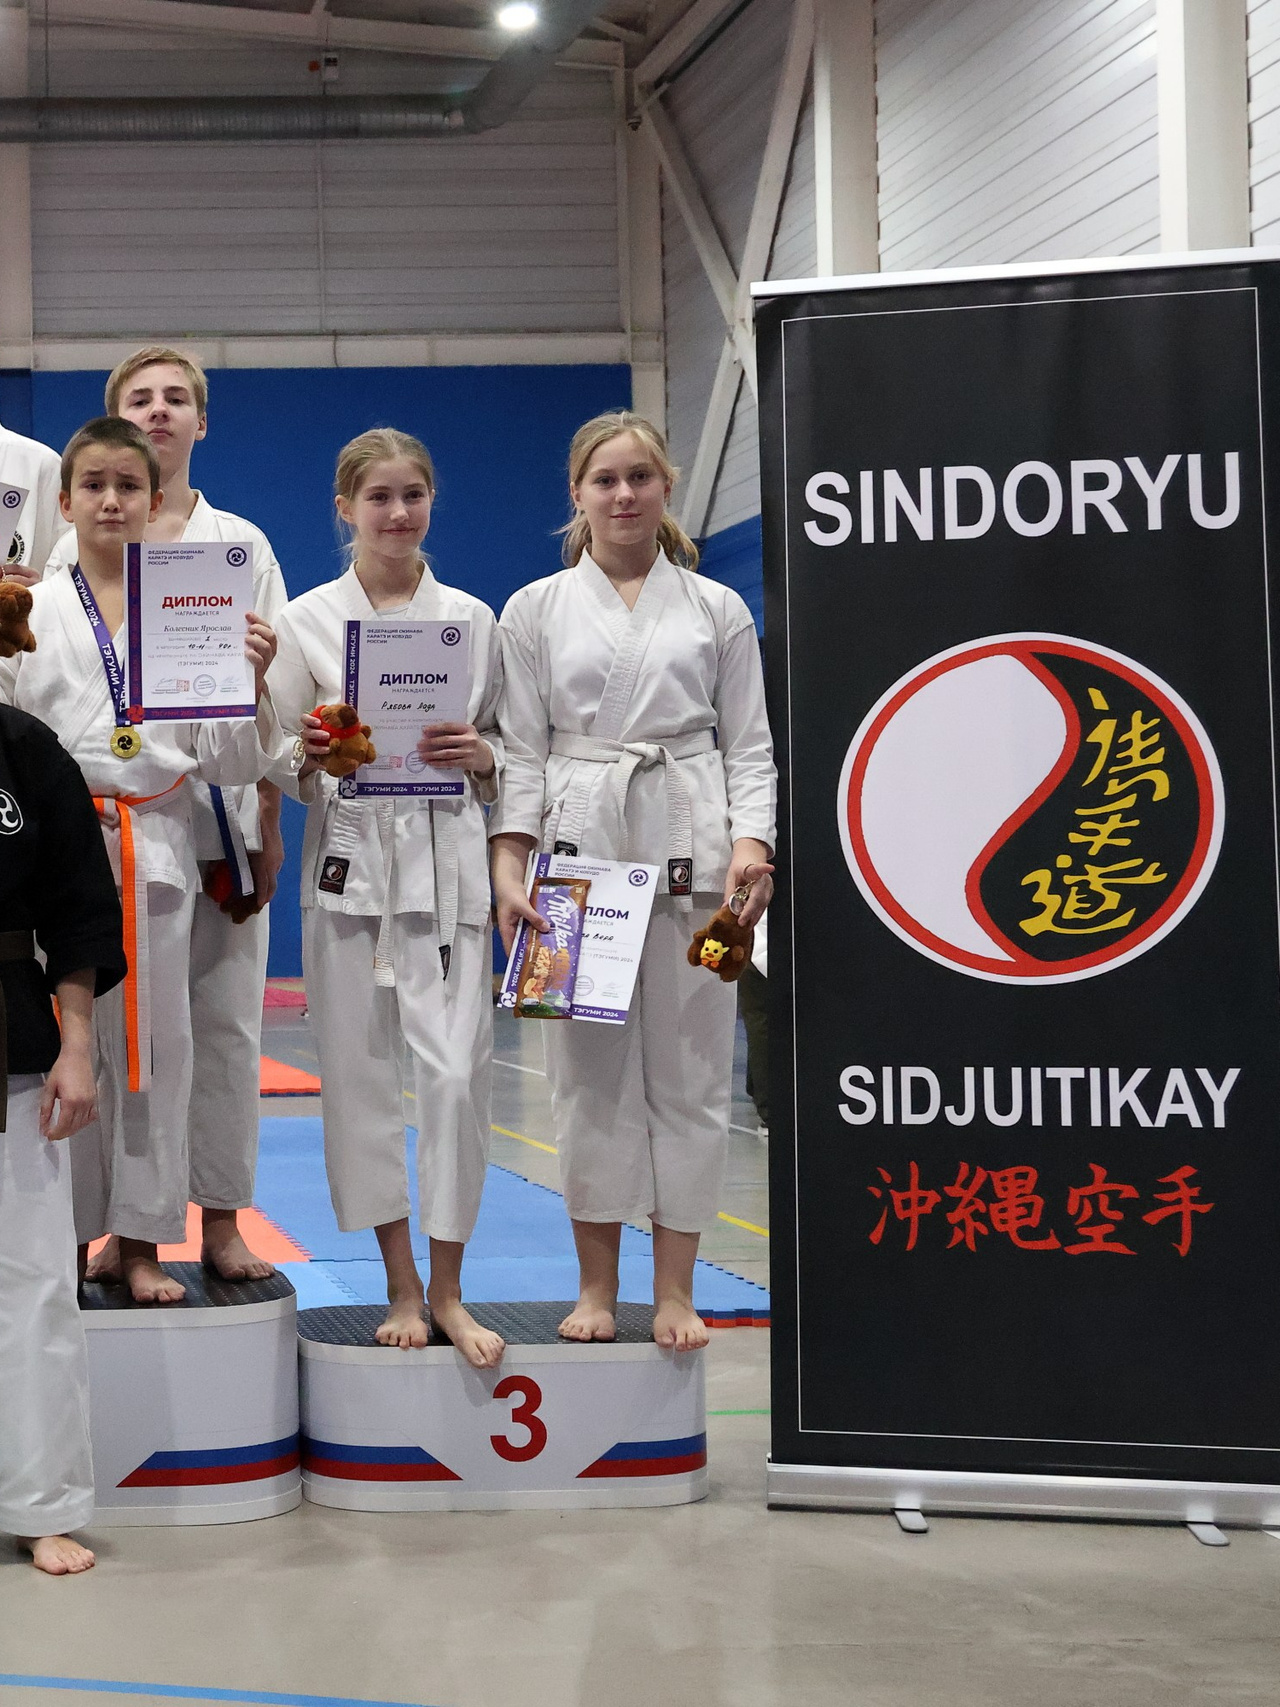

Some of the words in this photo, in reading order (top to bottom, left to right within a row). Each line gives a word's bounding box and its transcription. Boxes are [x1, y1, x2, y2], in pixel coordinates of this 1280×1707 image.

[803, 451, 1241, 547] SINDORYU
[74, 574, 91, 607] ТЭГУМИ
[86, 605, 101, 627] 2024
[162, 596, 233, 609] ДИПЛОМ
[200, 624, 232, 633] Ярослав
[349, 629, 357, 658] ТЭГУМИ
[102, 643, 120, 686] ТЭГУМИ
[379, 673, 448, 686] ДИПЛОМ
[585, 906, 629, 920] ПЛОМ
[511, 972, 520, 987] 2024
[573, 1007, 602, 1016] ТЭГУМИ
[602, 1010, 619, 1018] 2024
[837, 1065, 1241, 1129] SIDJUITIKAY
[866, 1160, 1215, 1257] 沖縄空手
[490, 1375, 548, 1462] 3
